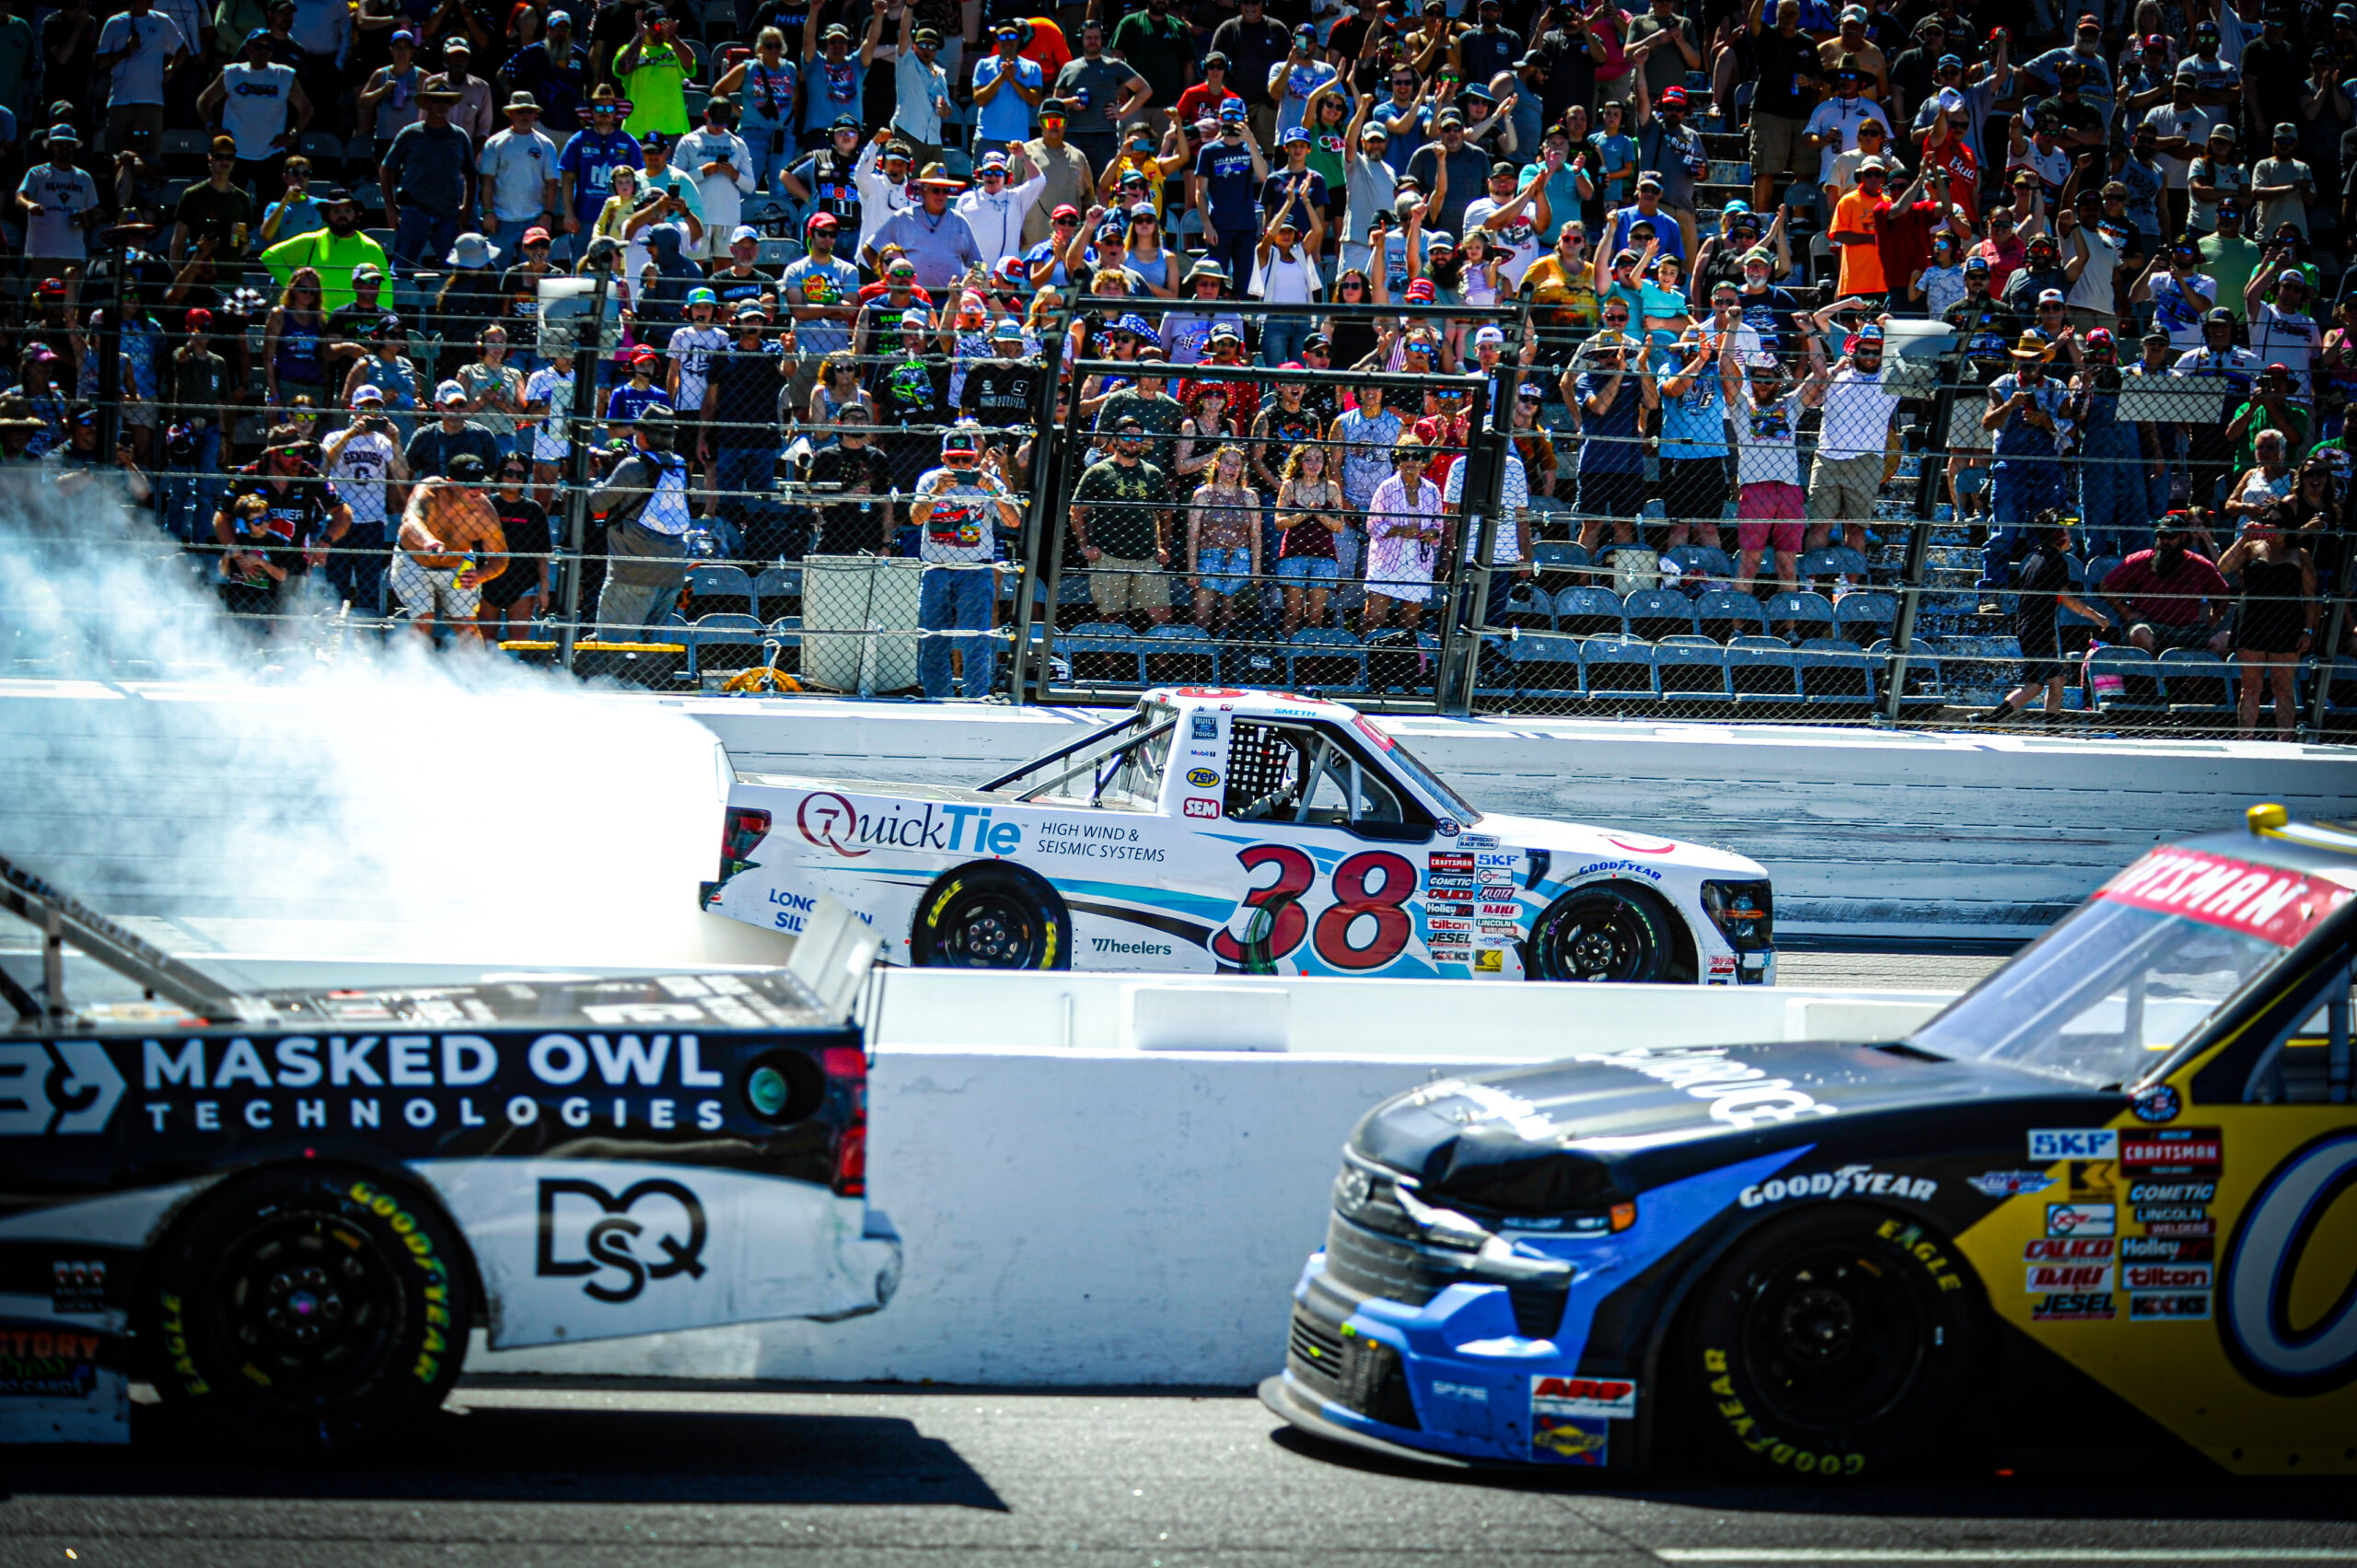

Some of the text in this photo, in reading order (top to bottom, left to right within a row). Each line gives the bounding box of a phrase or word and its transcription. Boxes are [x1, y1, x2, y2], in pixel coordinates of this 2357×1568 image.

[820, 183, 858, 201] Mob
[343, 450, 384, 467] SENIORS
[1195, 716, 1216, 726] BUILT
[1273, 708, 1317, 716] SMITH
[1185, 799, 1218, 818] SEM
[1040, 821, 1140, 842] HIGH WIND &
[1037, 839, 1166, 862] SEISMIC SYSTEMS
[1478, 854, 1519, 865] SKF
[1431, 858, 1472, 866] CRAFTSMAN
[1579, 859, 1662, 880] GOODYEAR
[1430, 877, 1472, 886] COMETIC
[1483, 889, 1513, 899] KLOTZ
[1213, 843, 1418, 971] 38
[1427, 903, 1457, 914] Holley
[1430, 919, 1470, 930] tilton
[1478, 919, 1512, 927] LINCOLN
[1428, 933, 1472, 943] JESEL
[142, 1032, 725, 1090] MASKED OWL
[145, 1095, 726, 1133] TECHNOLOGIES
[2033, 1133, 2115, 1156] SKF
[2124, 1144, 2217, 1161] CRAFTSMAN
[1740, 1165, 1937, 1208] GOODYEAR
[2131, 1180, 2214, 1202] COMETIC
[2138, 1208, 2202, 1222] LINCOLN
[2152, 1222, 2209, 1234] WELDERS
[1877, 1219, 1962, 1291] EAGLE
[2026, 1240, 2116, 1259] CALICO
[2122, 1238, 2180, 1260] Holley
[349, 1181, 449, 1384] GOODYEAR
[2127, 1268, 2208, 1288] tilton
[2034, 1294, 2118, 1313] JESEL
[1534, 1377, 1633, 1400] ARP
[1704, 1349, 1865, 1475] GOODYEAR
